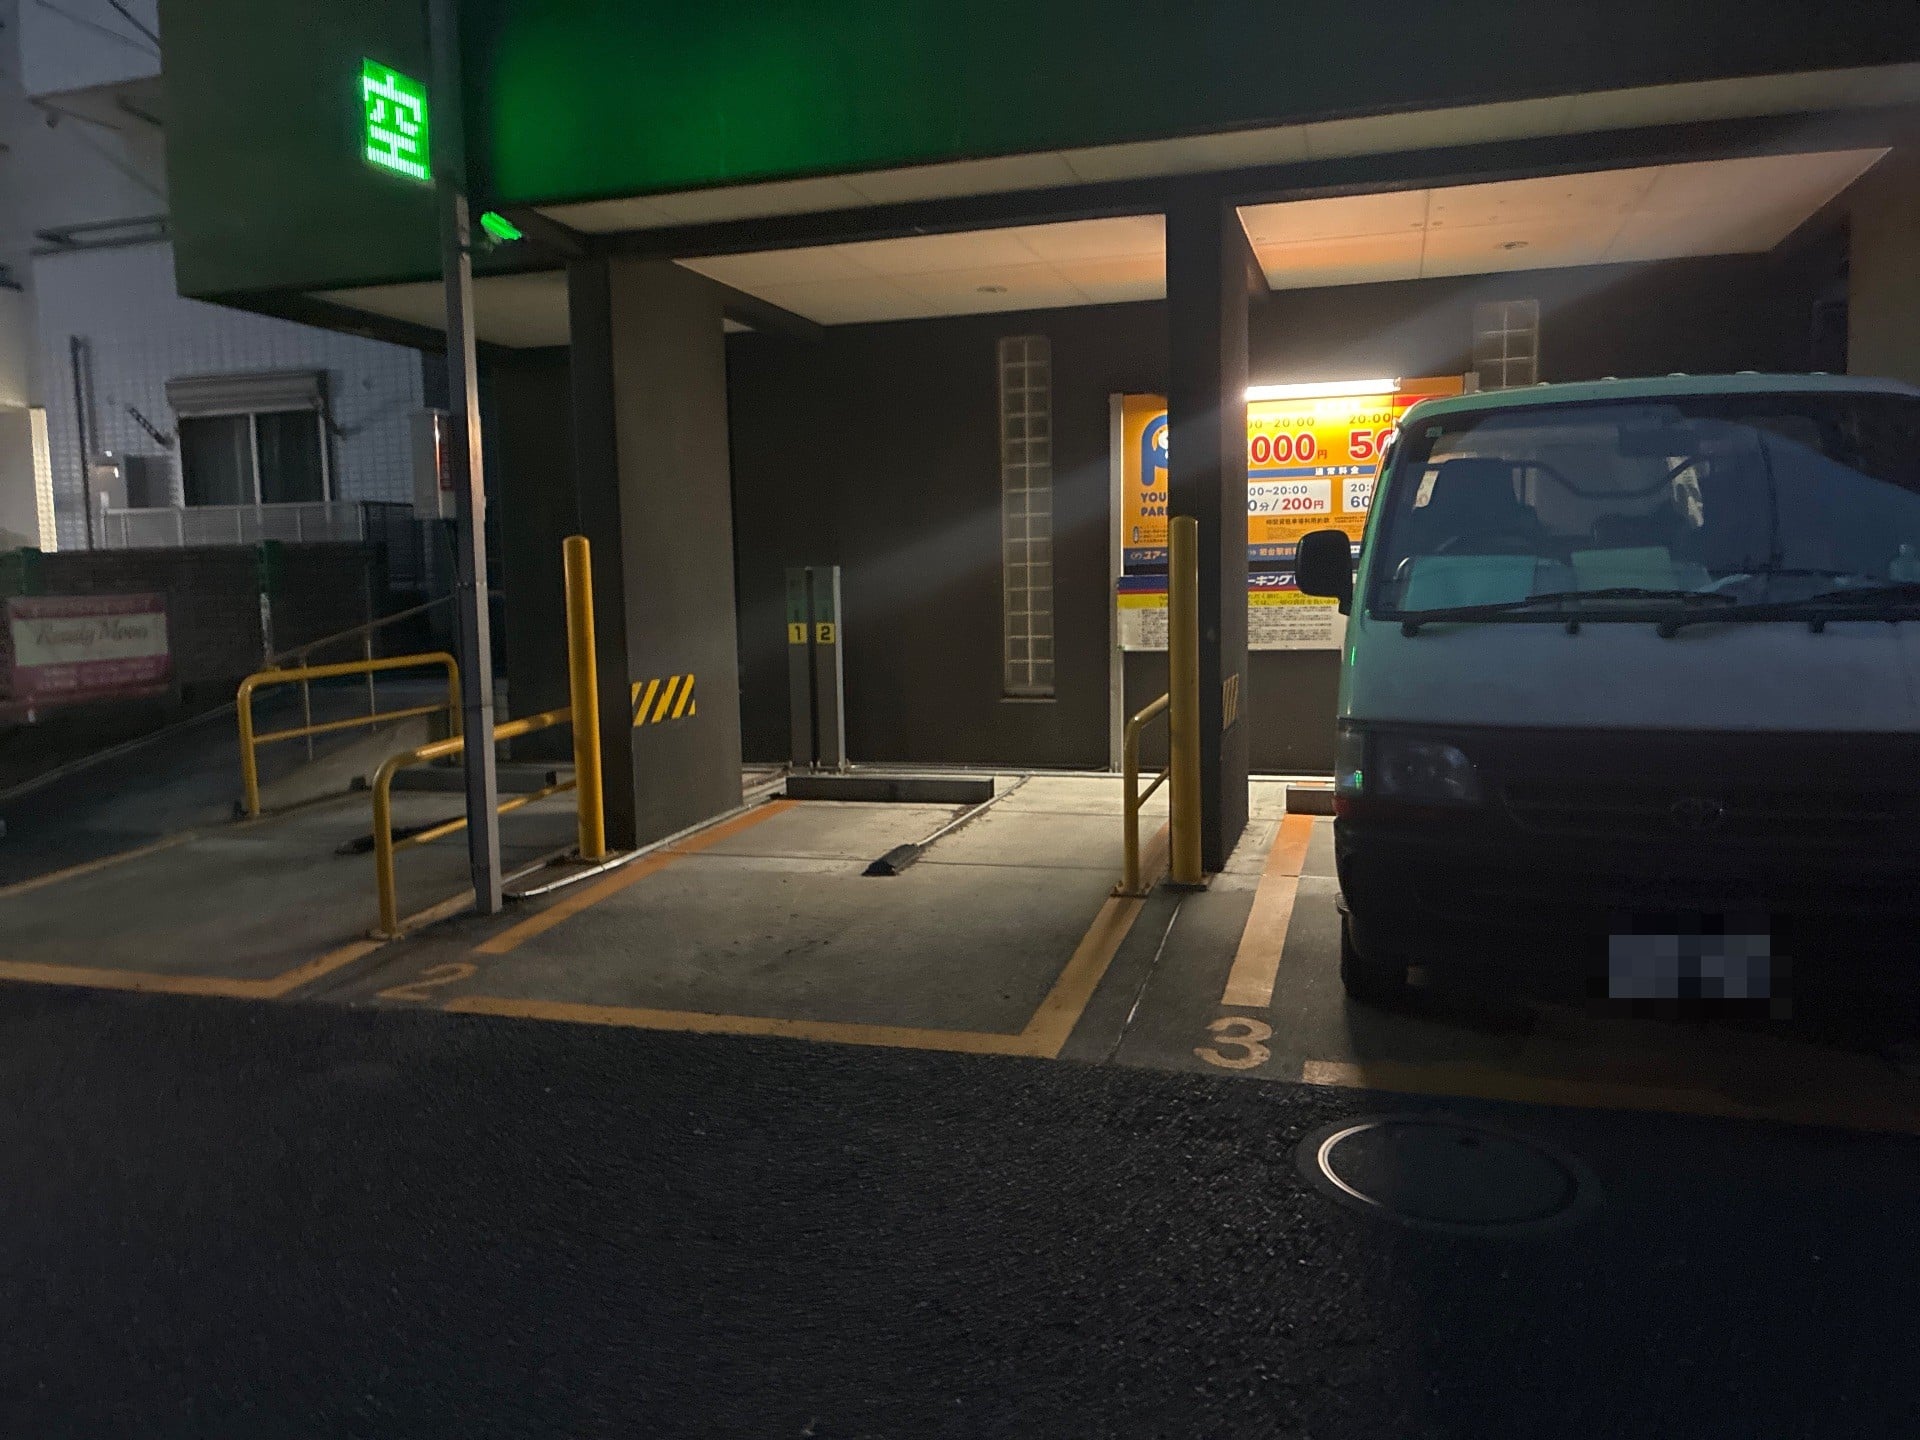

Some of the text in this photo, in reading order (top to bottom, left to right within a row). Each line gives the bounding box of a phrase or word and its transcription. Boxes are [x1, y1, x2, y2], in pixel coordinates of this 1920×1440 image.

[363, 74, 425, 180] 空
[1350, 483, 1373, 493] 20:
[1140, 506, 1168, 517] PAR
[795, 625, 831, 640] 1 2
[376, 963, 477, 1000] 2
[1192, 1015, 1273, 1070] 3
